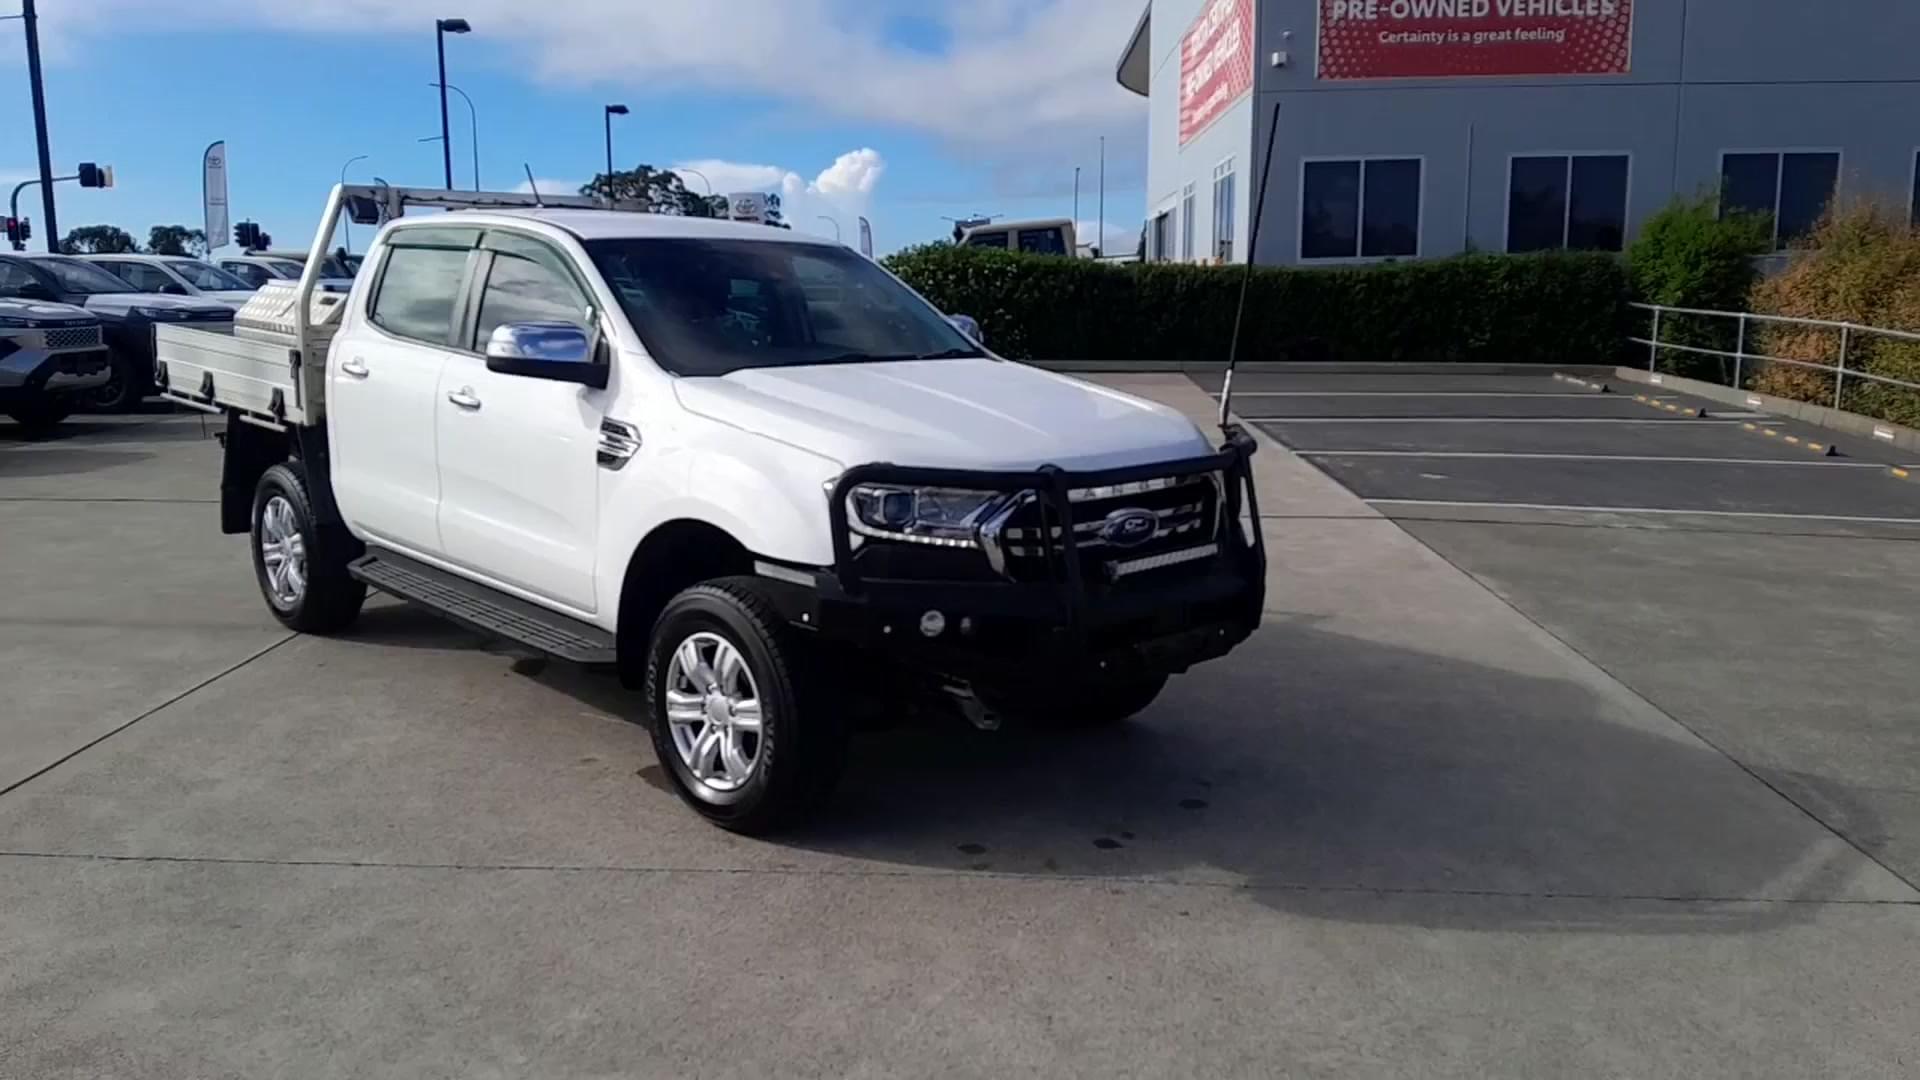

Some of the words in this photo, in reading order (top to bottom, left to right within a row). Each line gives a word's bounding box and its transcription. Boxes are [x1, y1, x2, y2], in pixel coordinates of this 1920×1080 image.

[1332, 0, 1490, 20] PRE-OWNED
[1495, 0, 1616, 17] VEHICLES
[1379, 29, 1445, 45] Certainty
[1447, 29, 1459, 42] is
[1462, 31, 1471, 42] a
[1473, 29, 1512, 44] great
[1514, 27, 1567, 43] feeling
